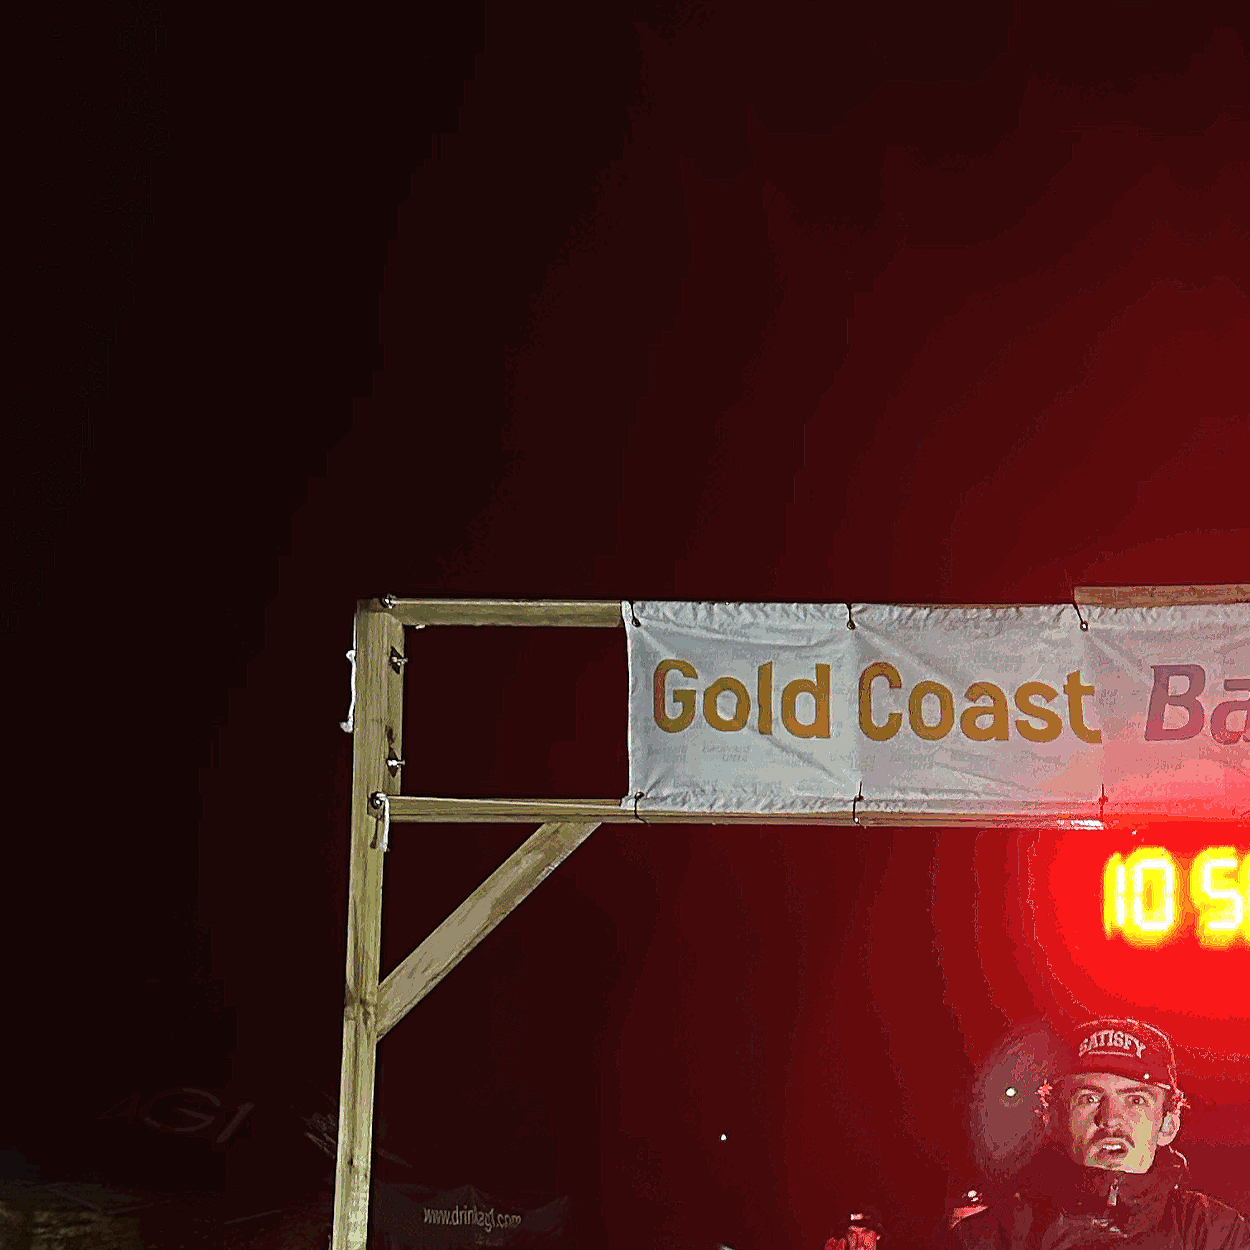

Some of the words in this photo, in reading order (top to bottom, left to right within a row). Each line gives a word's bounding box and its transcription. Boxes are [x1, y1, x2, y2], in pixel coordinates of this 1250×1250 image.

[652, 659, 831, 741] Gold
[857, 661, 1103, 744] Coast
[1106, 850, 1179, 944] 10
[1078, 1028, 1147, 1059] SATISFY
